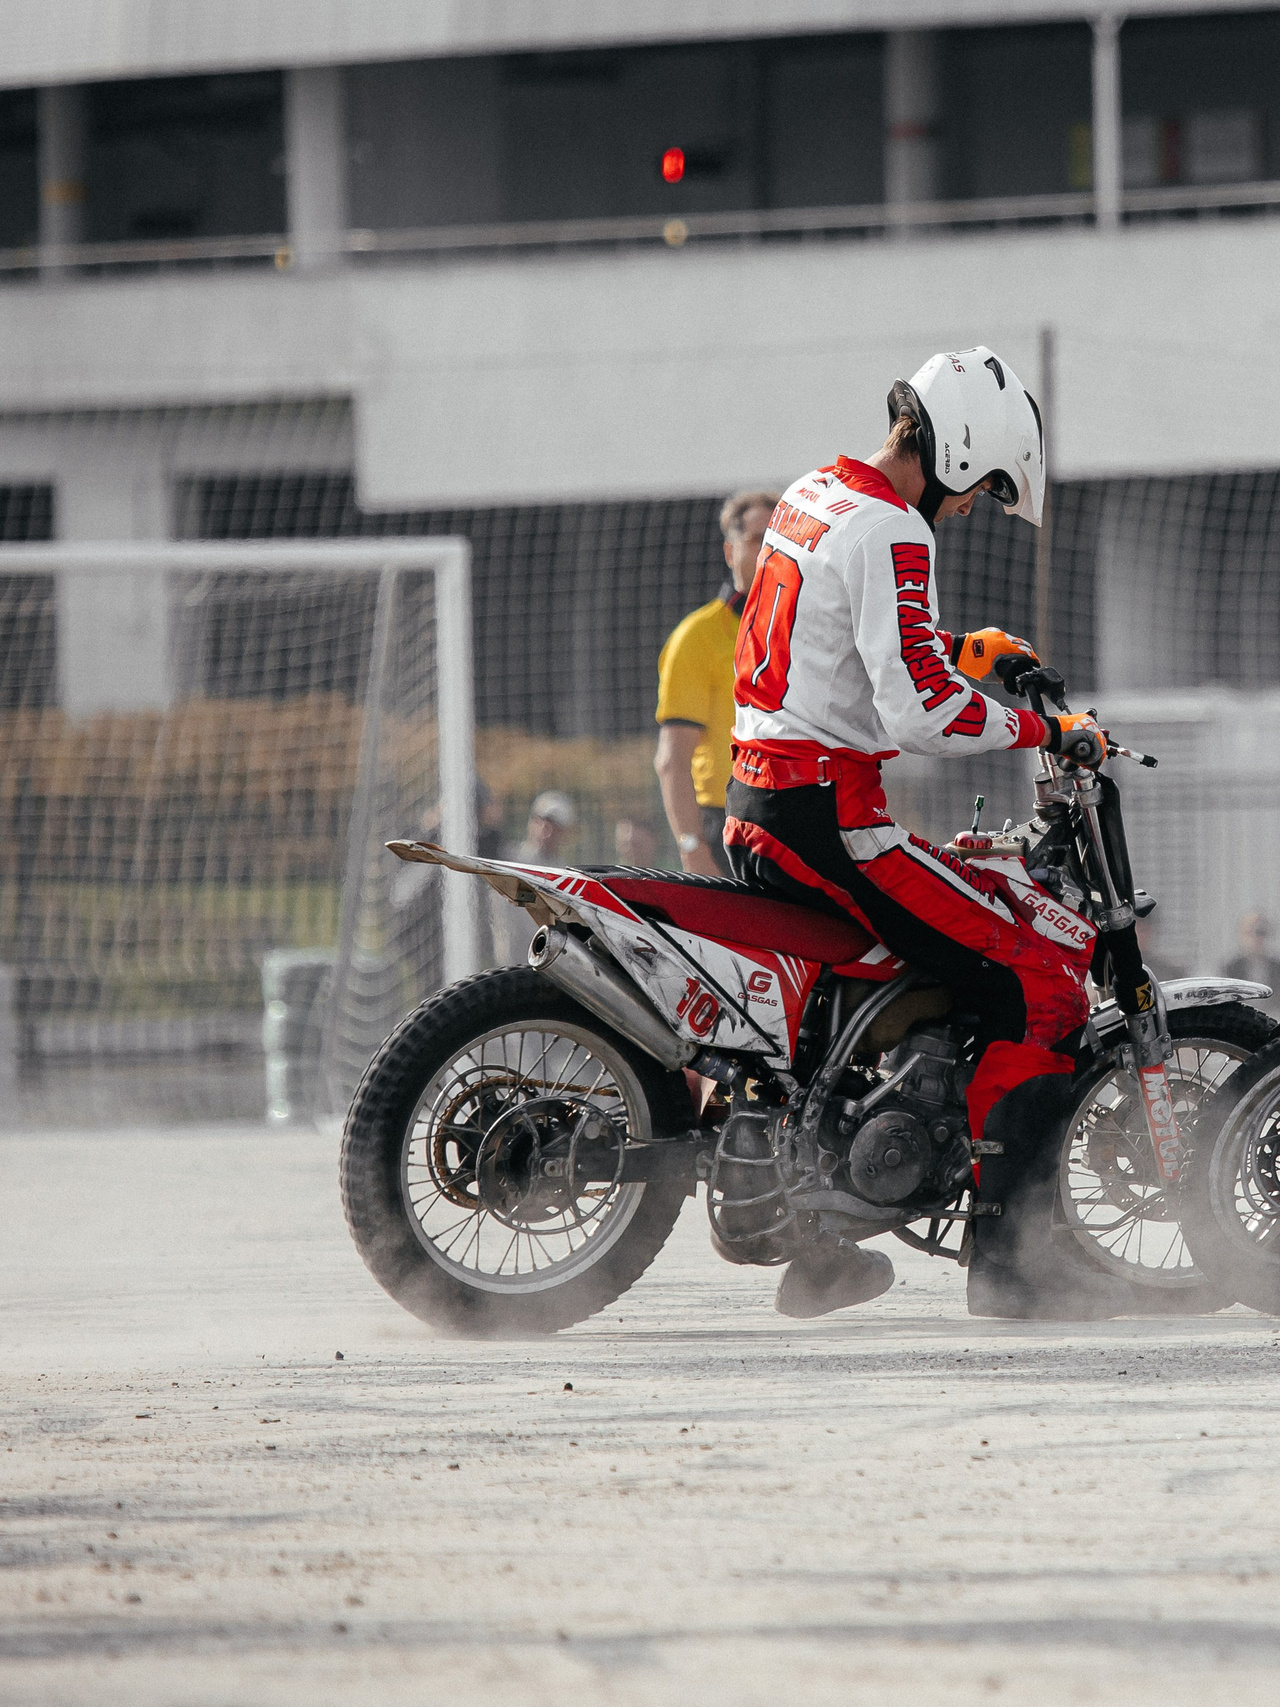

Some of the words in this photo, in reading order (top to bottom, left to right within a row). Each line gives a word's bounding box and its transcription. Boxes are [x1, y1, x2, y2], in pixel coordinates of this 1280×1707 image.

[1022, 893, 1088, 944] GASGAS
[676, 977, 719, 1037] 10
[737, 992, 778, 1007] GASGAS
[1143, 1072, 1180, 1177] MOTUL
